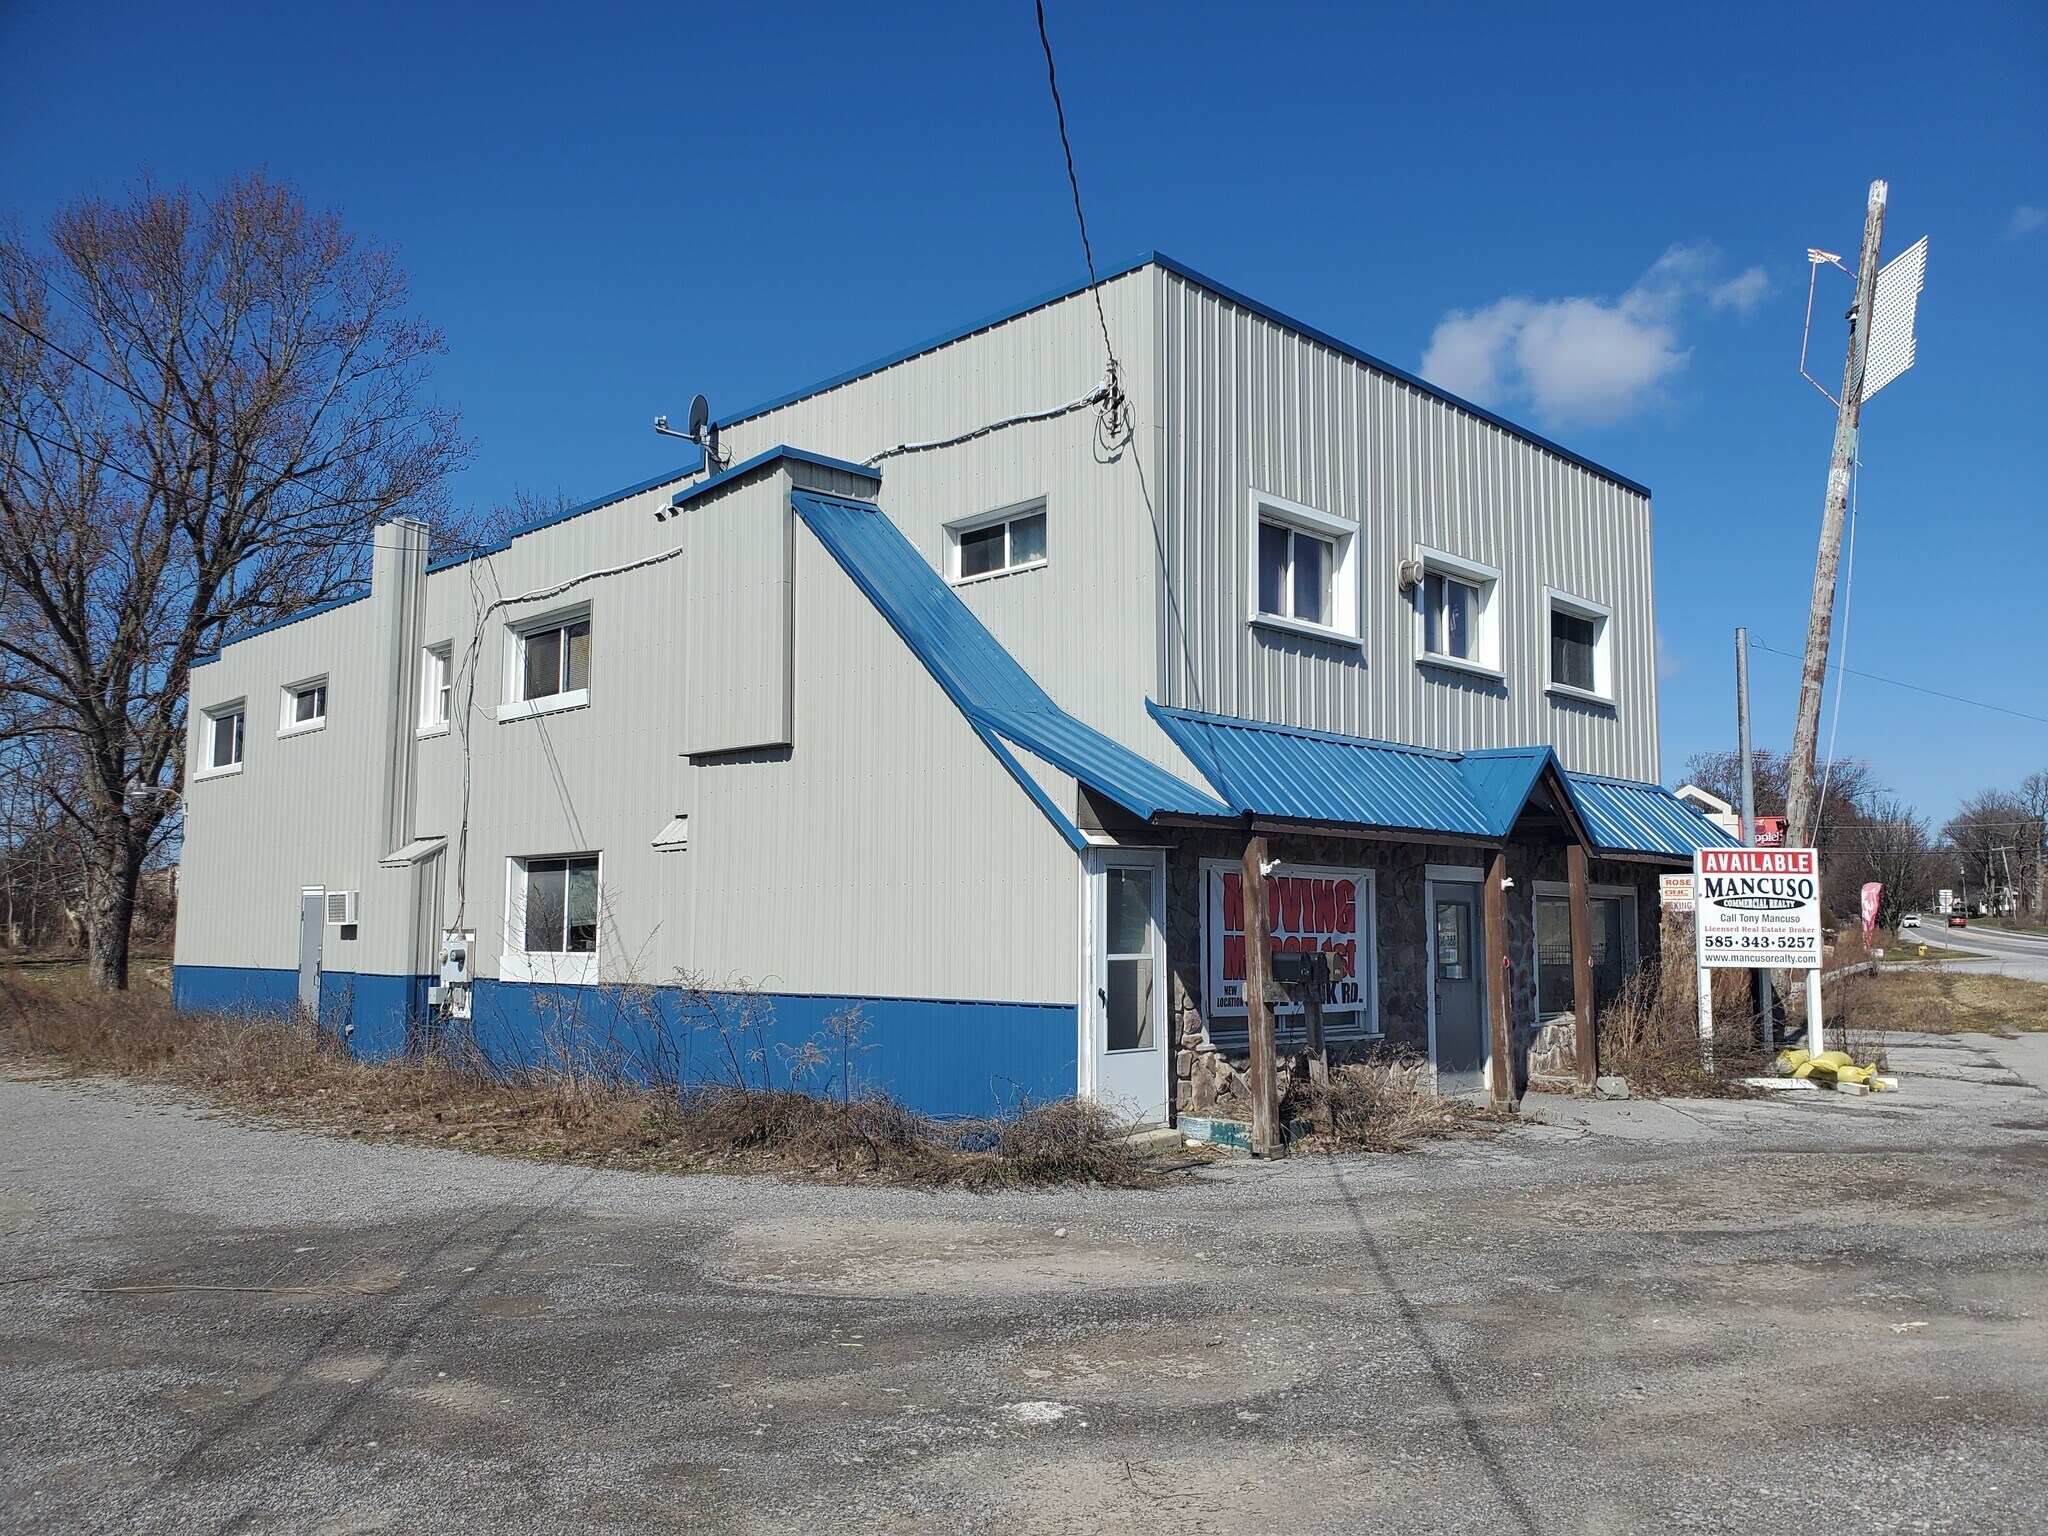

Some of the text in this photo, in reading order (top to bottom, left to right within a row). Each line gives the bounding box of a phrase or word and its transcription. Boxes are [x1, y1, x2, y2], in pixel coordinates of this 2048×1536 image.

[1705, 853, 1810, 872] AVAILABLE
[1704, 877, 1814, 899] MANCUSO
[1723, 898, 1796, 909] COMMERCIAL REALTY
[1720, 913, 1801, 925] Call Tony Mancuso
[1705, 954, 1816, 964] www.mancusorealty.com
[1223, 985, 1238, 996] NEW
[1341, 982, 1363, 1004] RD.
[1216, 996, 1244, 1008] LOCATION
